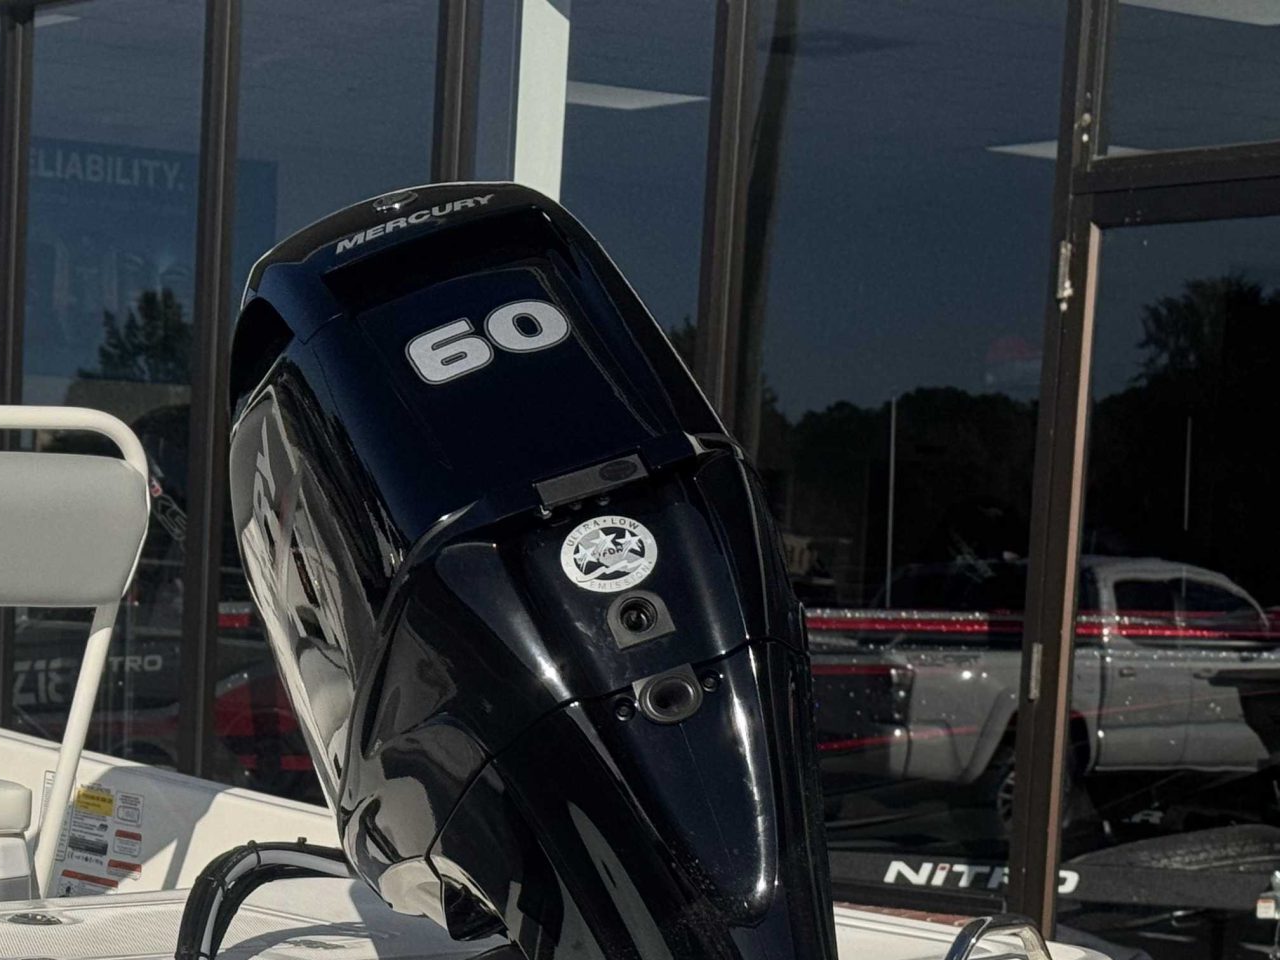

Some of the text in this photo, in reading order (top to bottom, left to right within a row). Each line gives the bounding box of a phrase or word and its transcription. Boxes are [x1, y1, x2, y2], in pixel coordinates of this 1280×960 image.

[334, 193, 495, 255] MERCURY
[404, 298, 571, 385] 60
[566, 517, 640, 548] ULTRA LOW
[107, 655, 163, 672] TRO
